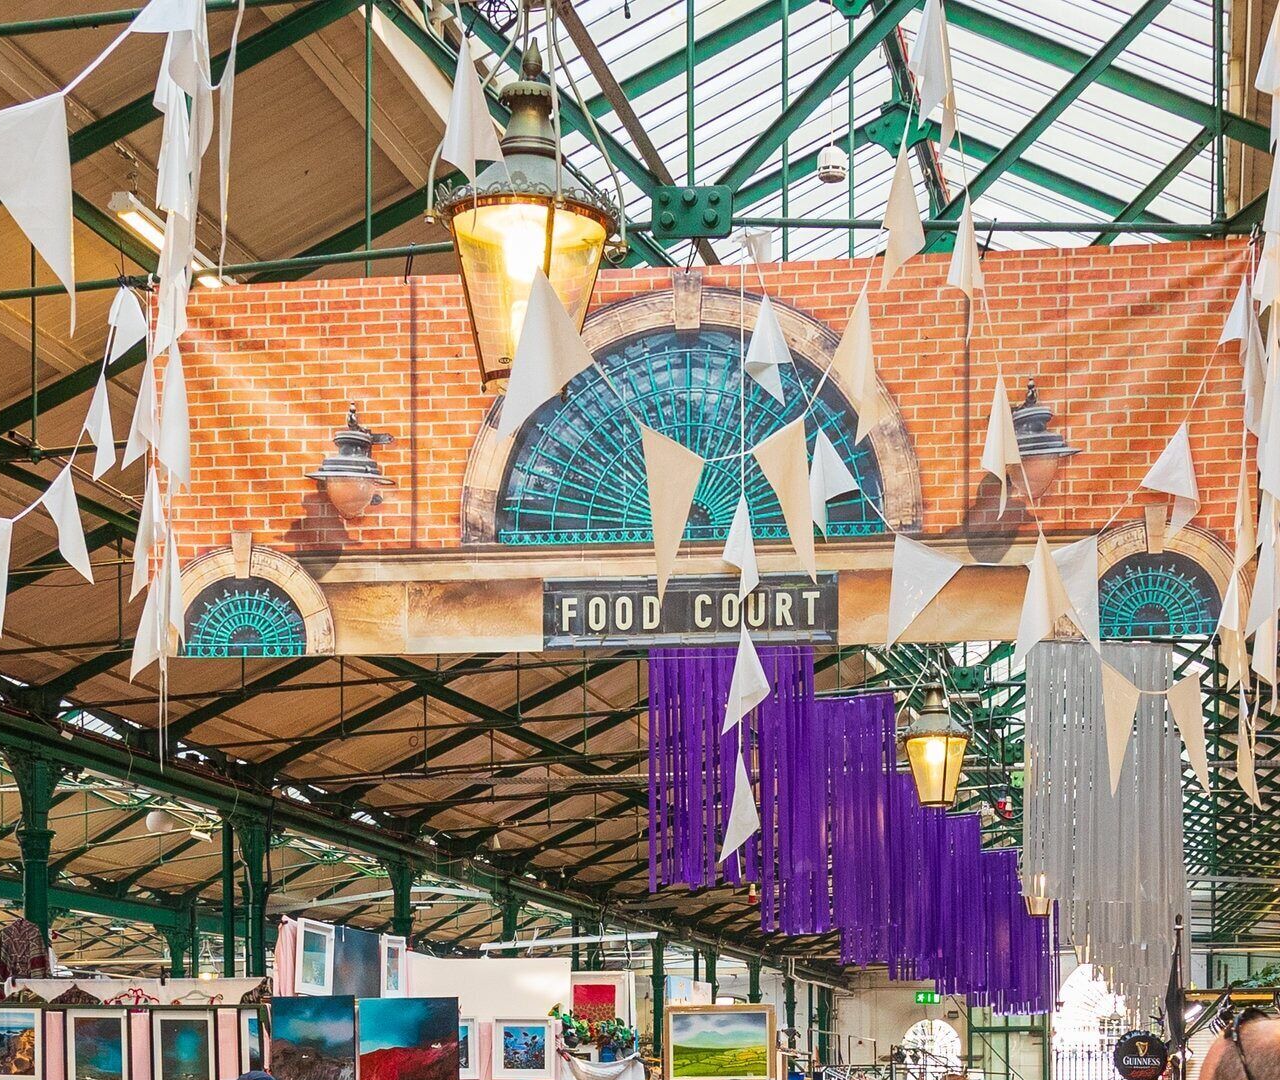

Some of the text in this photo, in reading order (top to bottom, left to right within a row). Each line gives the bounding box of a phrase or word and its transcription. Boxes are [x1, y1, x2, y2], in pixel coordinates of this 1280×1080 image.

[562, 590, 821, 632] FOOD COURT
[1122, 1056, 1161, 1066] GUINNESS
